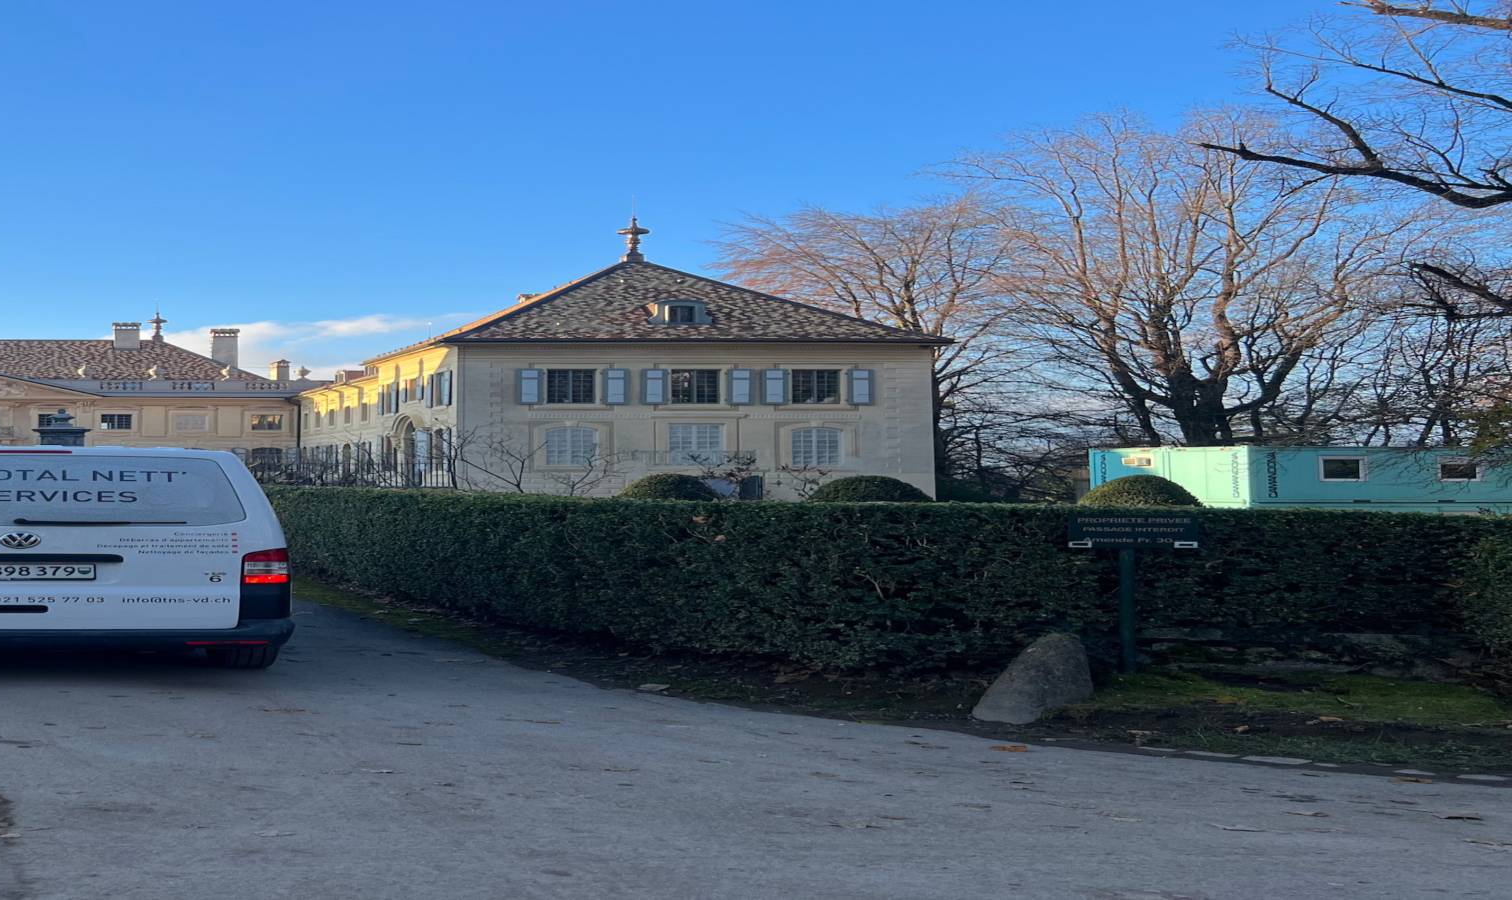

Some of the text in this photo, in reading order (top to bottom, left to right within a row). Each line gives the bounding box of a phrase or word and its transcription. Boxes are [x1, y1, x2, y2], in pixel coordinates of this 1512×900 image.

[1083, 536, 1134, 544] Amende
[28, 596, 56, 604] 525
[86, 596, 105, 604] 03
[121, 596, 231, 604] info@tns-vd.ch
